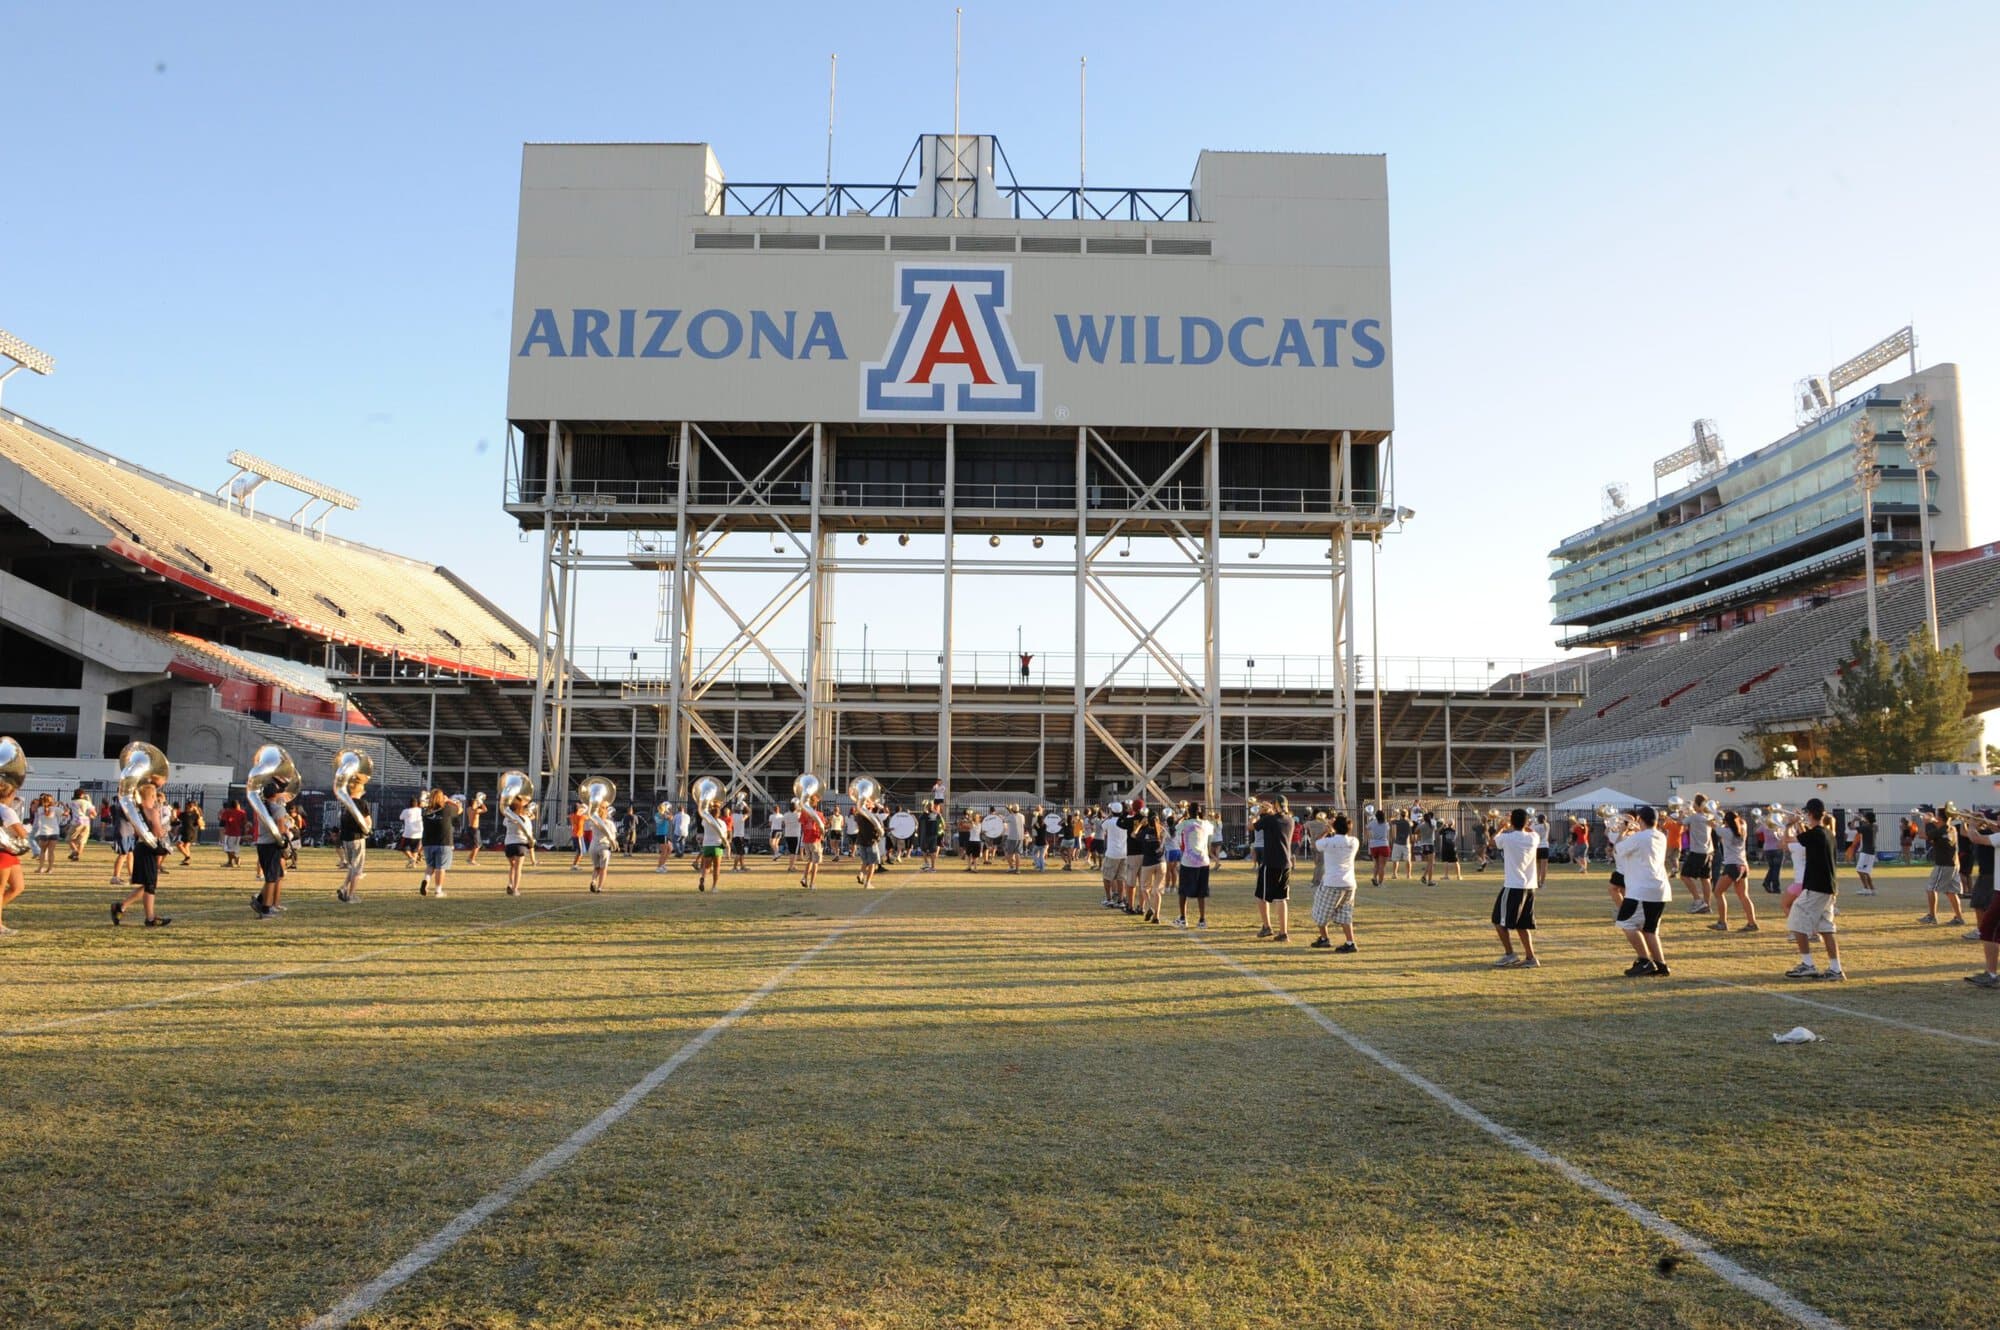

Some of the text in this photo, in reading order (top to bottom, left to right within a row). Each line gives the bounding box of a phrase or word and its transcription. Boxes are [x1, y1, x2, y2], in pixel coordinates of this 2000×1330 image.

[518, 308, 848, 360] ARIZONA
[862, 264, 1041, 417] A
[1054, 313, 1386, 369] WILDCATS
